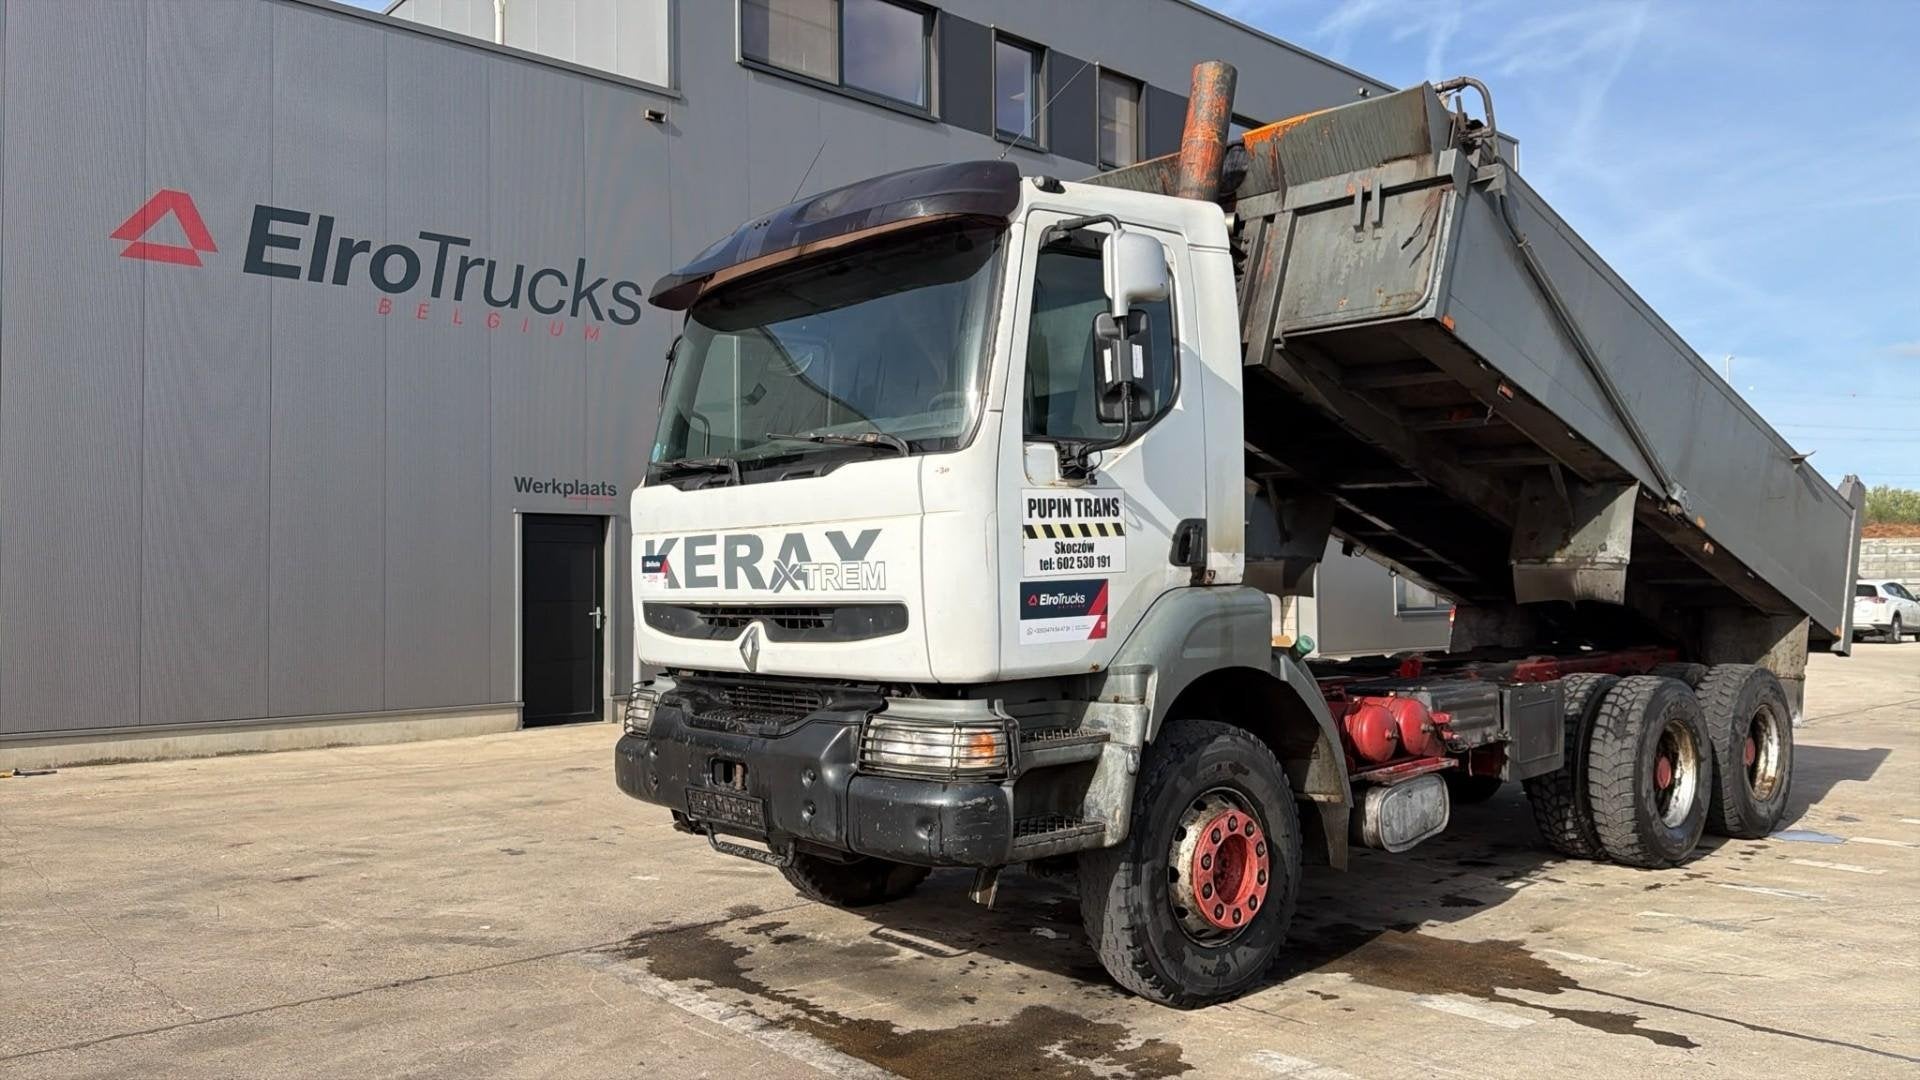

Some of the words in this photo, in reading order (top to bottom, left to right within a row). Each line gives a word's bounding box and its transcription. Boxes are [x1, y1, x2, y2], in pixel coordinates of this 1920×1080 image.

[243, 204, 643, 326] ElroTrucks
[377, 297, 601, 342] BELGIUM
[513, 476, 617, 498] Werkplaats
[1027, 498, 1072, 519] PUPIN
[1074, 497, 1120, 518] TRANS
[1054, 540, 1095, 554] Skoczów
[1039, 557, 1055, 571] tel:
[1056, 556, 1075, 570] 602
[1076, 555, 1095, 569] 530
[1096, 555, 1111, 568] 191
[769, 559, 887, 594] XTREM
[1039, 592, 1086, 606] ElroTrucks
